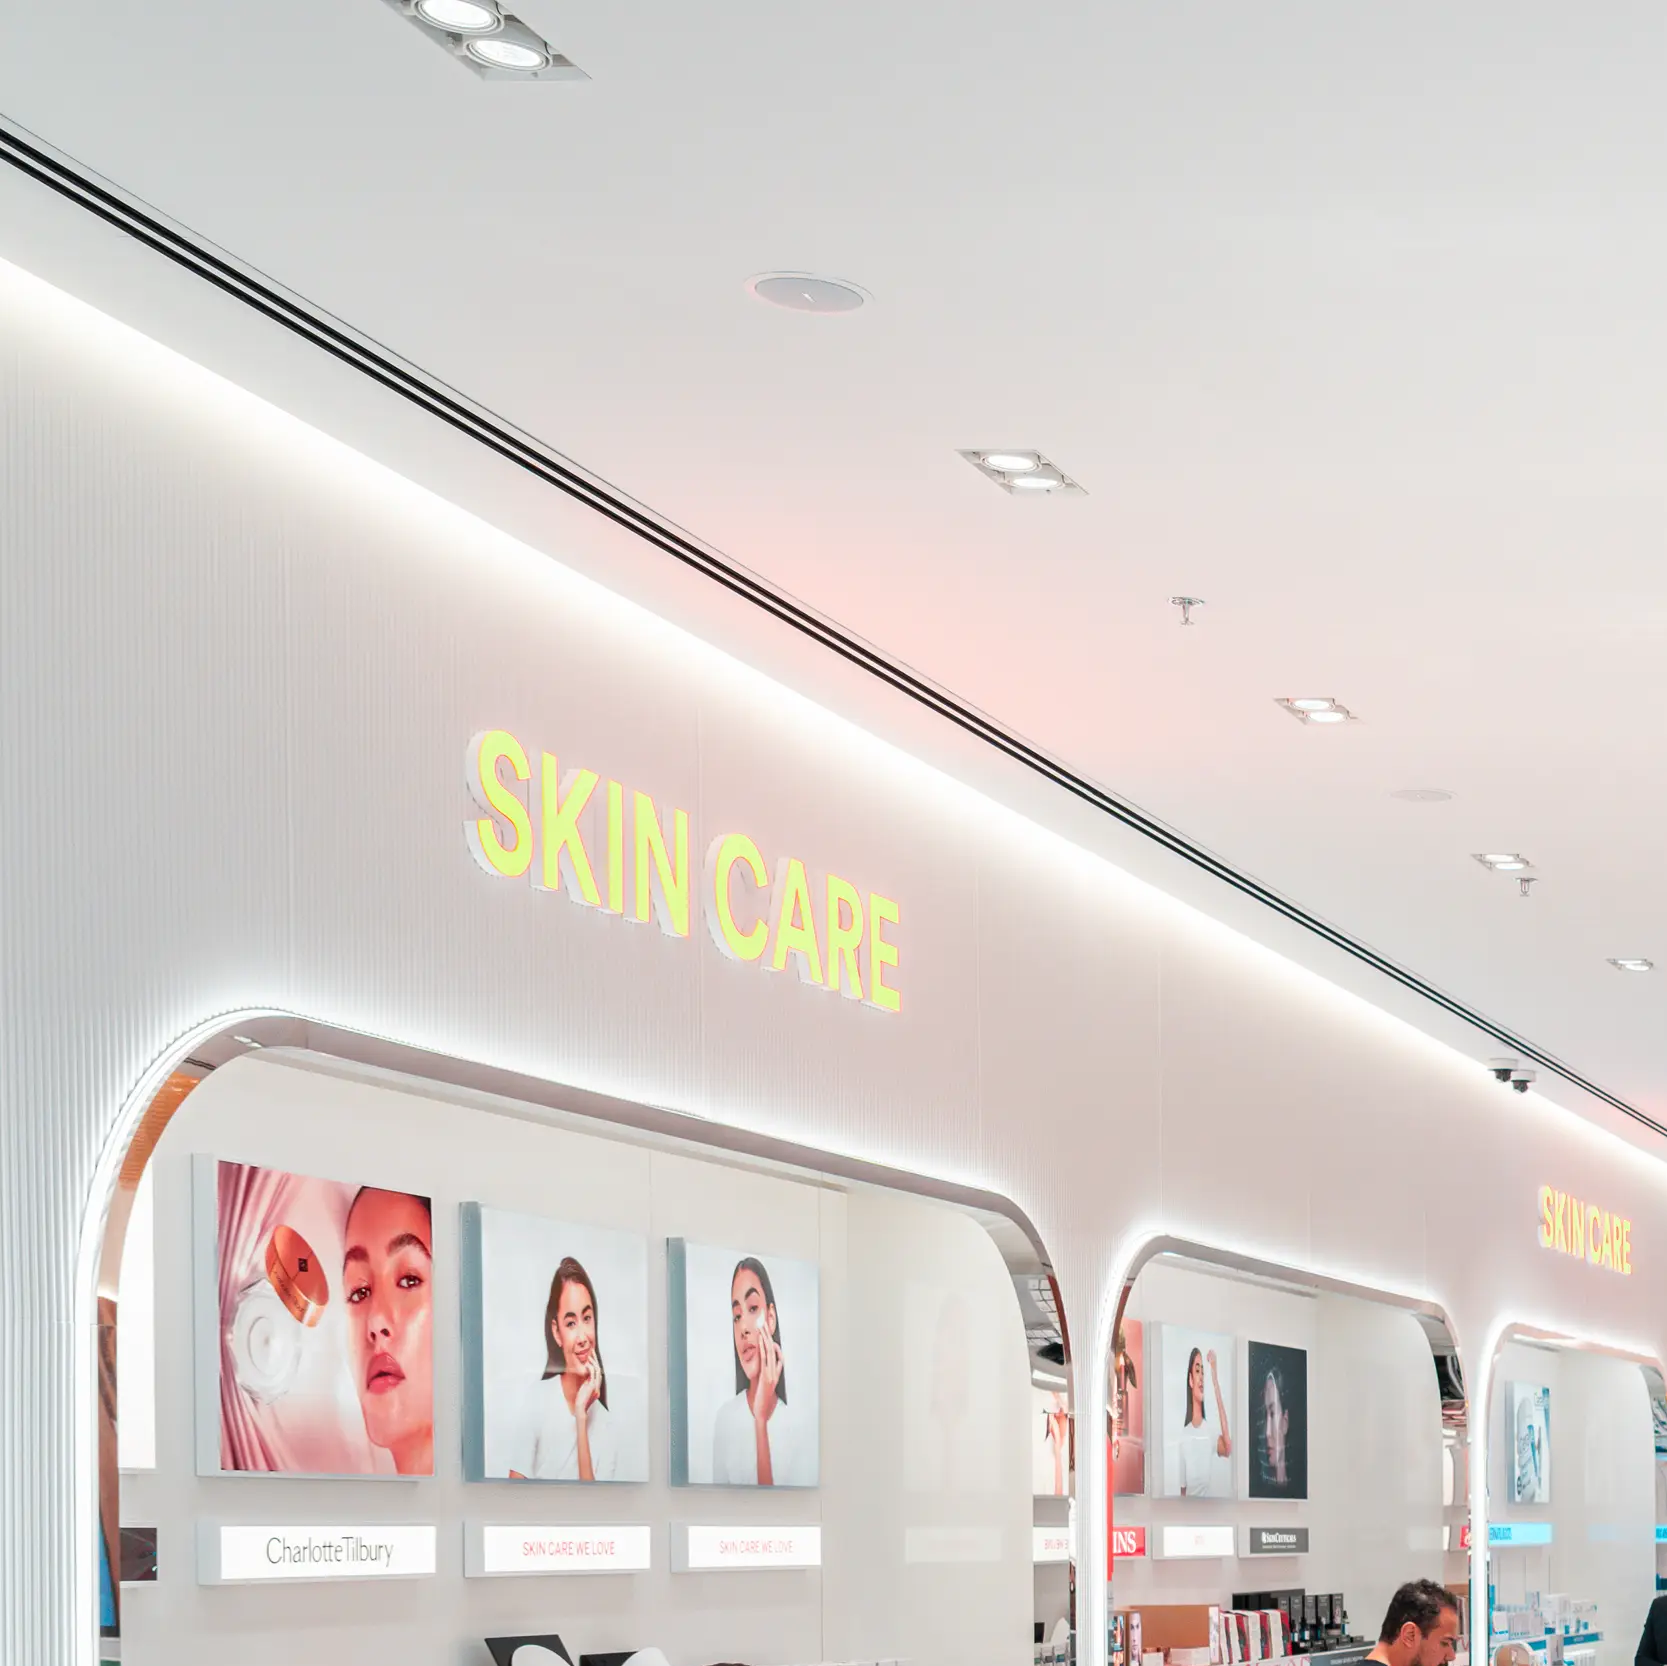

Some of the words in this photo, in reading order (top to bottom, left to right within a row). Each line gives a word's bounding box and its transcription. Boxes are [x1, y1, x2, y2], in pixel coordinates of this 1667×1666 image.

[466, 728, 689, 937] SKIN
[705, 834, 902, 1012] CARE
[1539, 1185, 1585, 1260] SKIN
[1588, 1206, 1632, 1275] CARE
[522, 1541, 546, 1556] SKIN
[548, 1541, 574, 1556] CARE
[576, 1541, 590, 1555] WE
[592, 1540, 615, 1555] LOVE
[719, 1540, 740, 1554] SKIN
[741, 1540, 760, 1553] CARE
[761, 1540, 773, 1552] WE
[774, 1539, 793, 1552] LOVE
